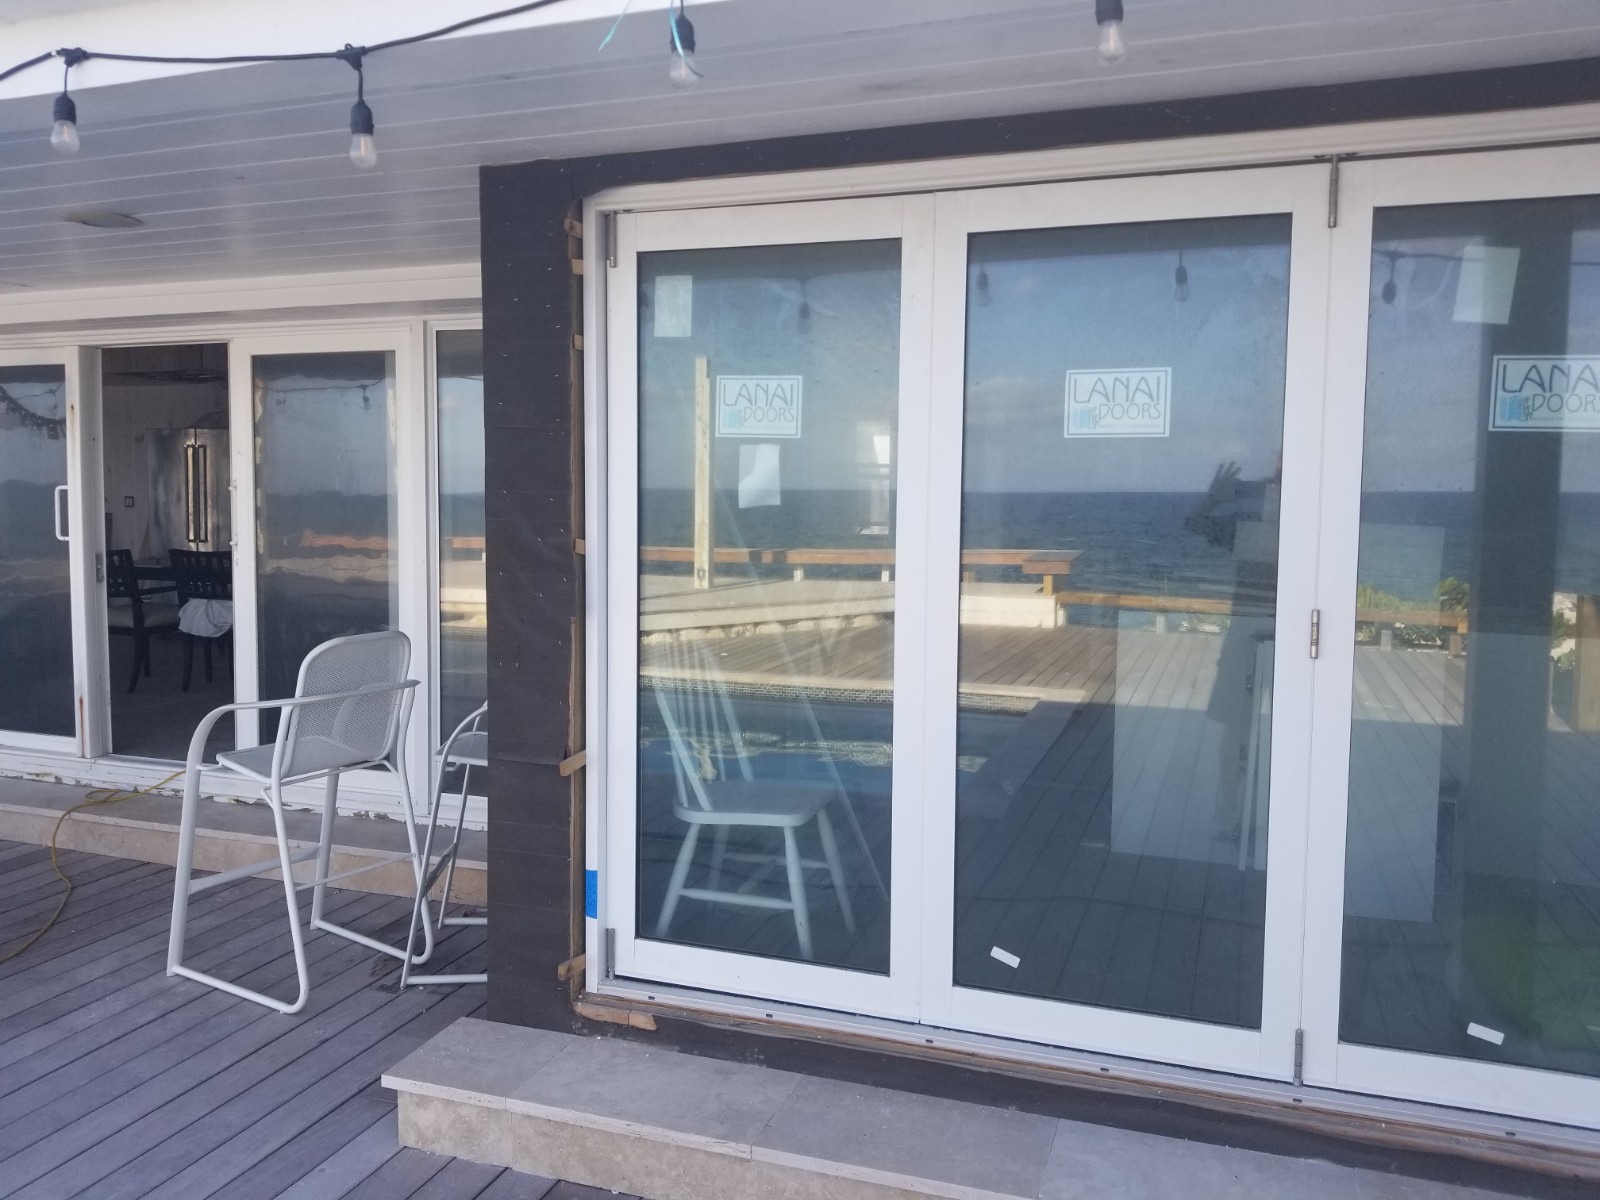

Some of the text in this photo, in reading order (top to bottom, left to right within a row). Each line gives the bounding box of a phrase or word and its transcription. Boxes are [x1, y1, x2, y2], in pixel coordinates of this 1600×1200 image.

[723, 383, 794, 407] LANAI
[1073, 376, 1160, 403] LANAI
[1098, 402, 1162, 420] DOORS
[1532, 393, 1600, 413] DOOR
[743, 406, 794, 423] DOORS
